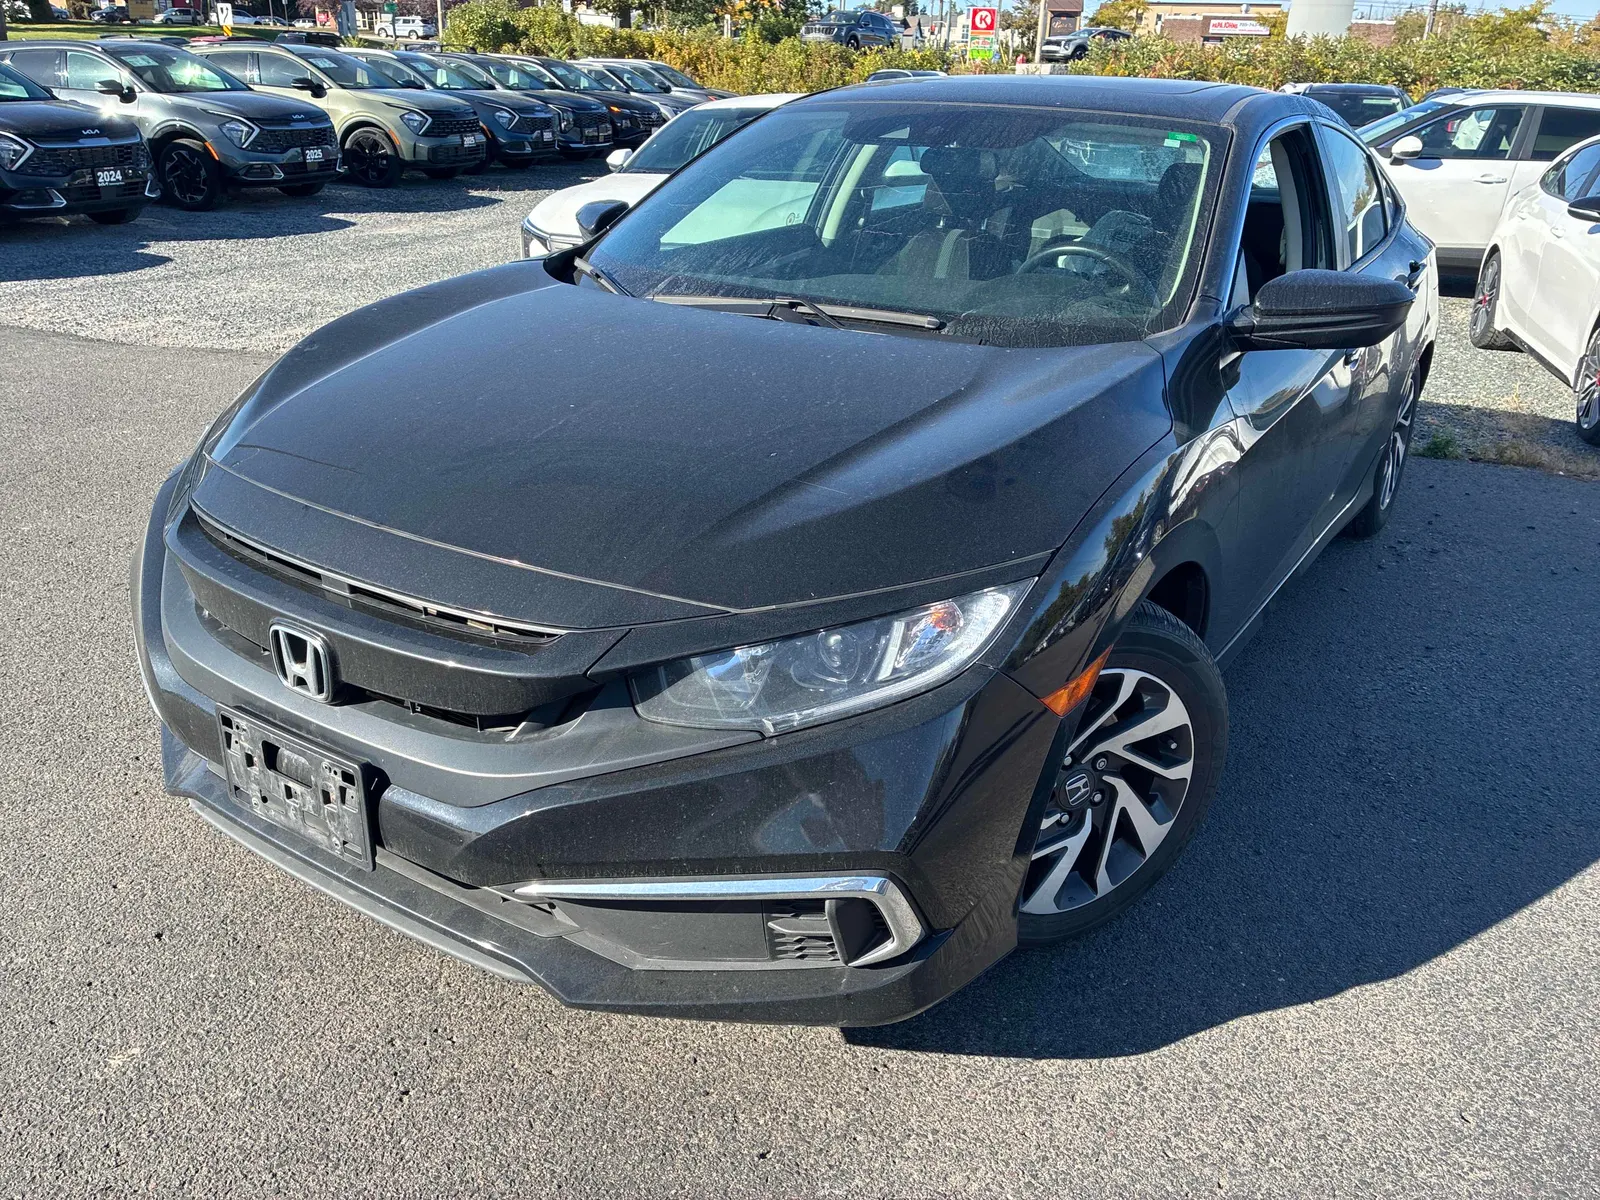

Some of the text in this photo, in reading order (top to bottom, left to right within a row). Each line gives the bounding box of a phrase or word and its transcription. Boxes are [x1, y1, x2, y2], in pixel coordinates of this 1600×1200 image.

[979, 14, 990, 27] K
[305, 149, 323, 159] 2025
[97, 170, 123, 183] 2024
